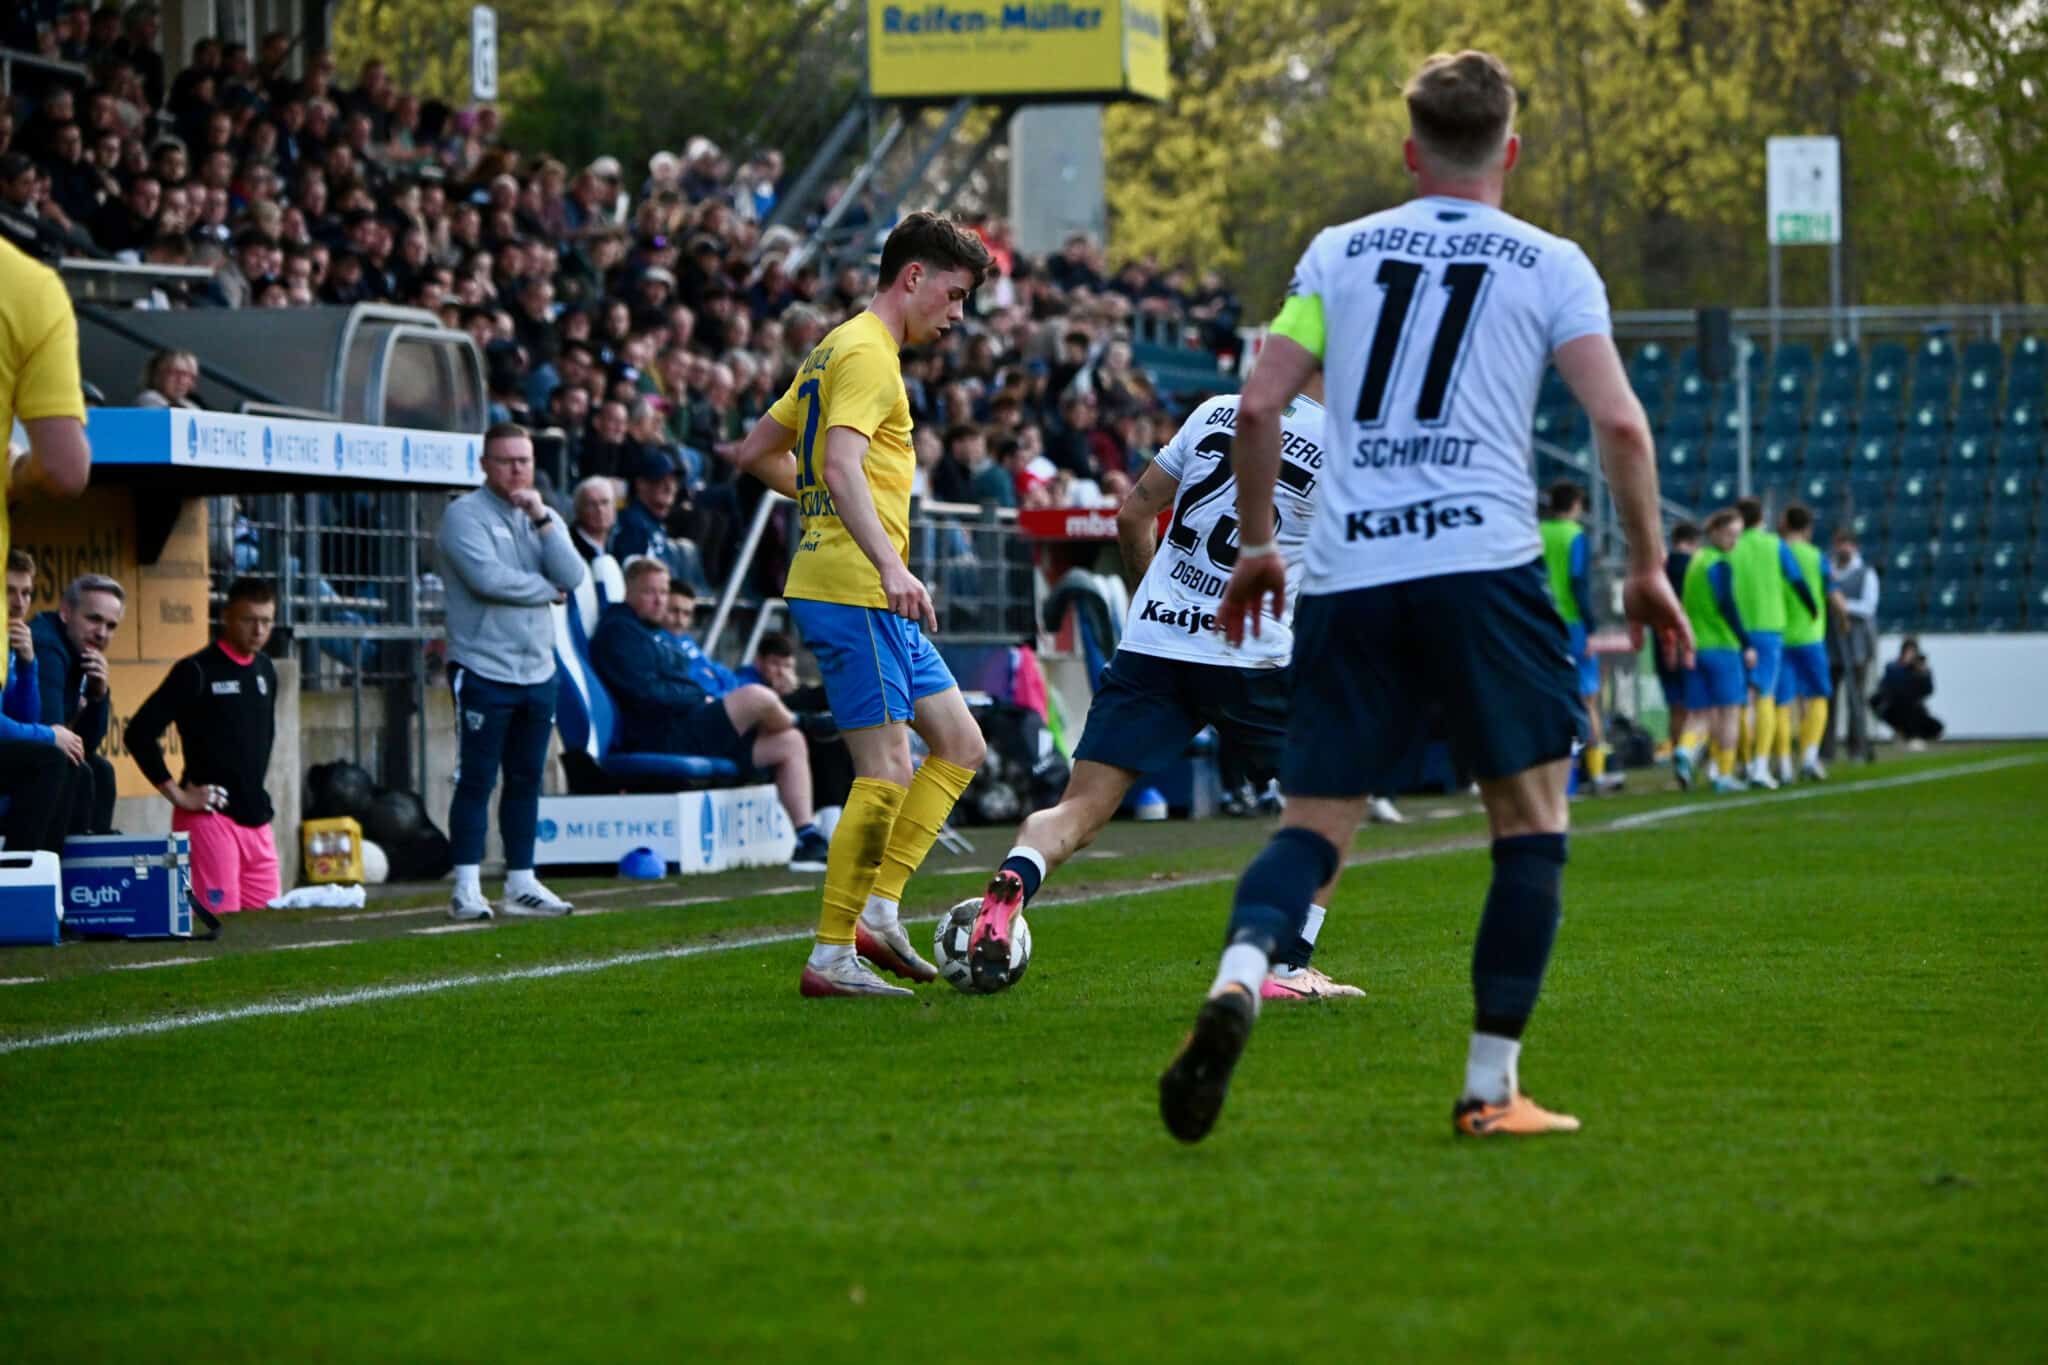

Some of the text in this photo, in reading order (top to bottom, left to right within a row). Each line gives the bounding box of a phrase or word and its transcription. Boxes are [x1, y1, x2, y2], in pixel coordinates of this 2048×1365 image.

[1346, 228, 1541, 269] BABELSBERG
[1354, 258, 1495, 430] 11
[201, 427, 247, 457] MIETHKE
[1353, 437, 1478, 468] SCHMIDT
[1345, 501, 1484, 542] Katjes
[566, 820, 675, 839] MIETHKE
